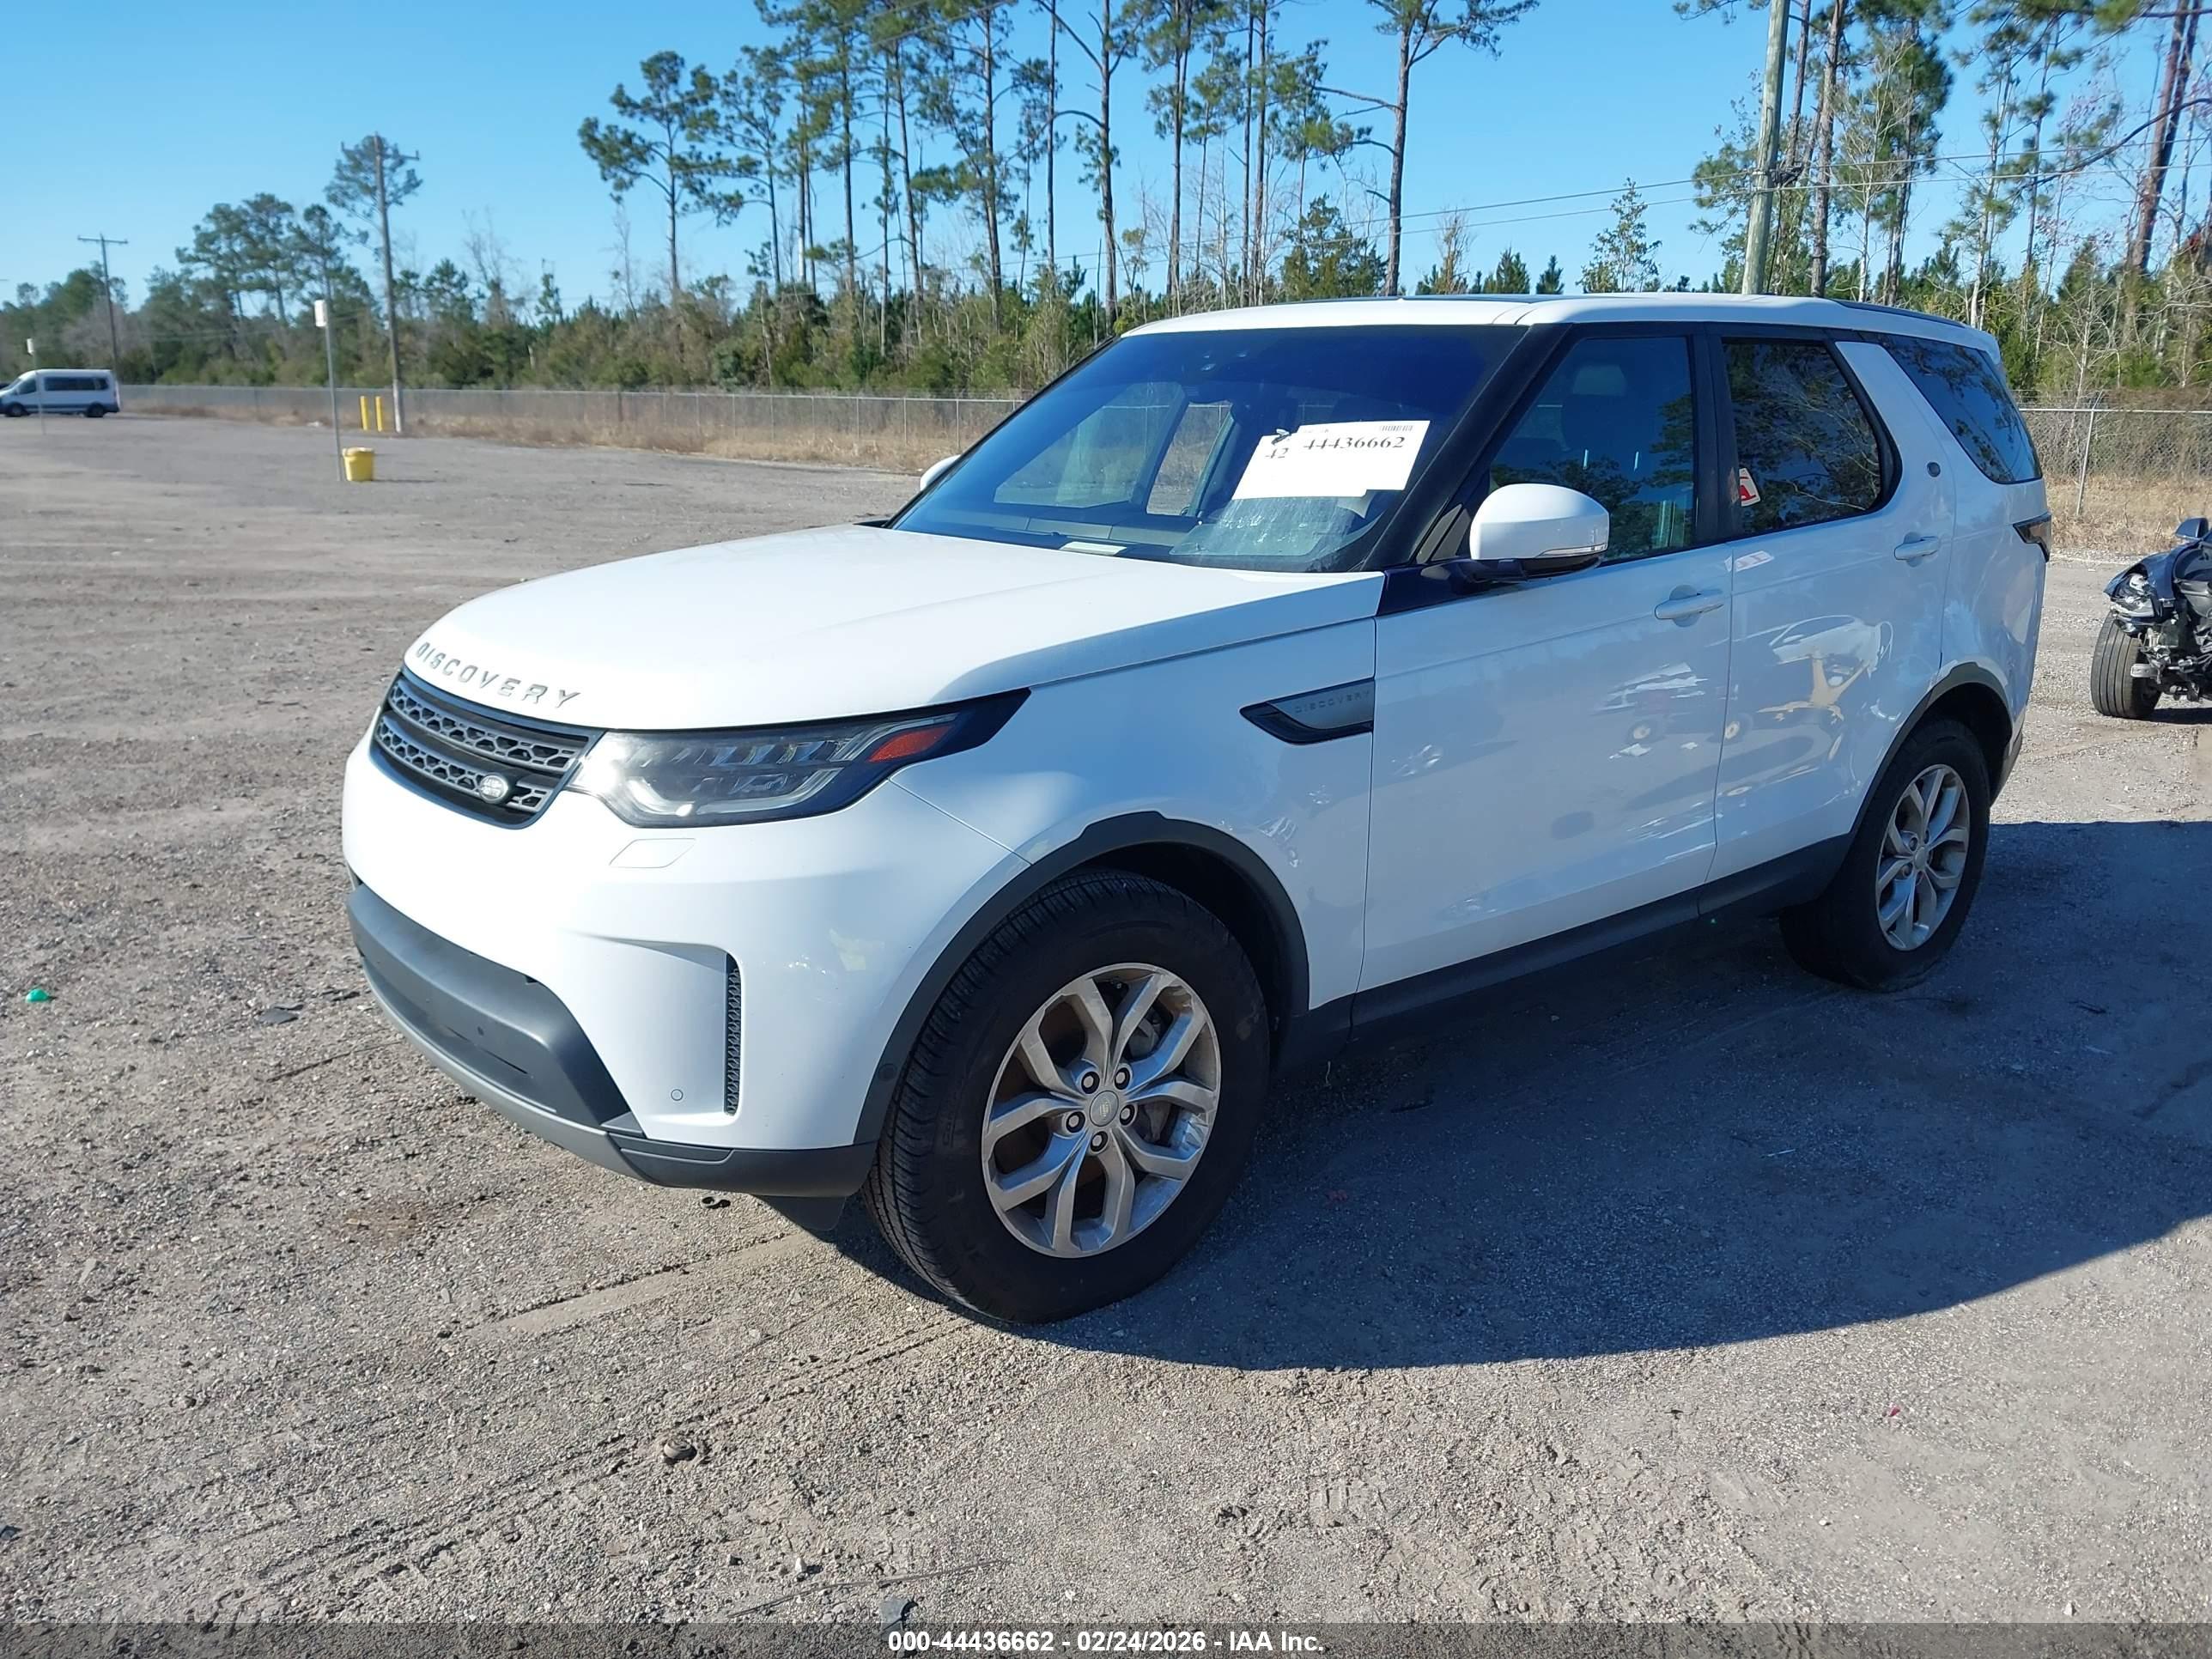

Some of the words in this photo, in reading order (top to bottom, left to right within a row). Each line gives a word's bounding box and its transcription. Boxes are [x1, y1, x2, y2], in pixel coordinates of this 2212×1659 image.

[1303, 436, 1406, 450] 44436662
[1264, 447, 1290, 459] 42
[416, 641, 581, 708] DISCOVERY
[1295, 690, 1370, 714] DISCOVERY
